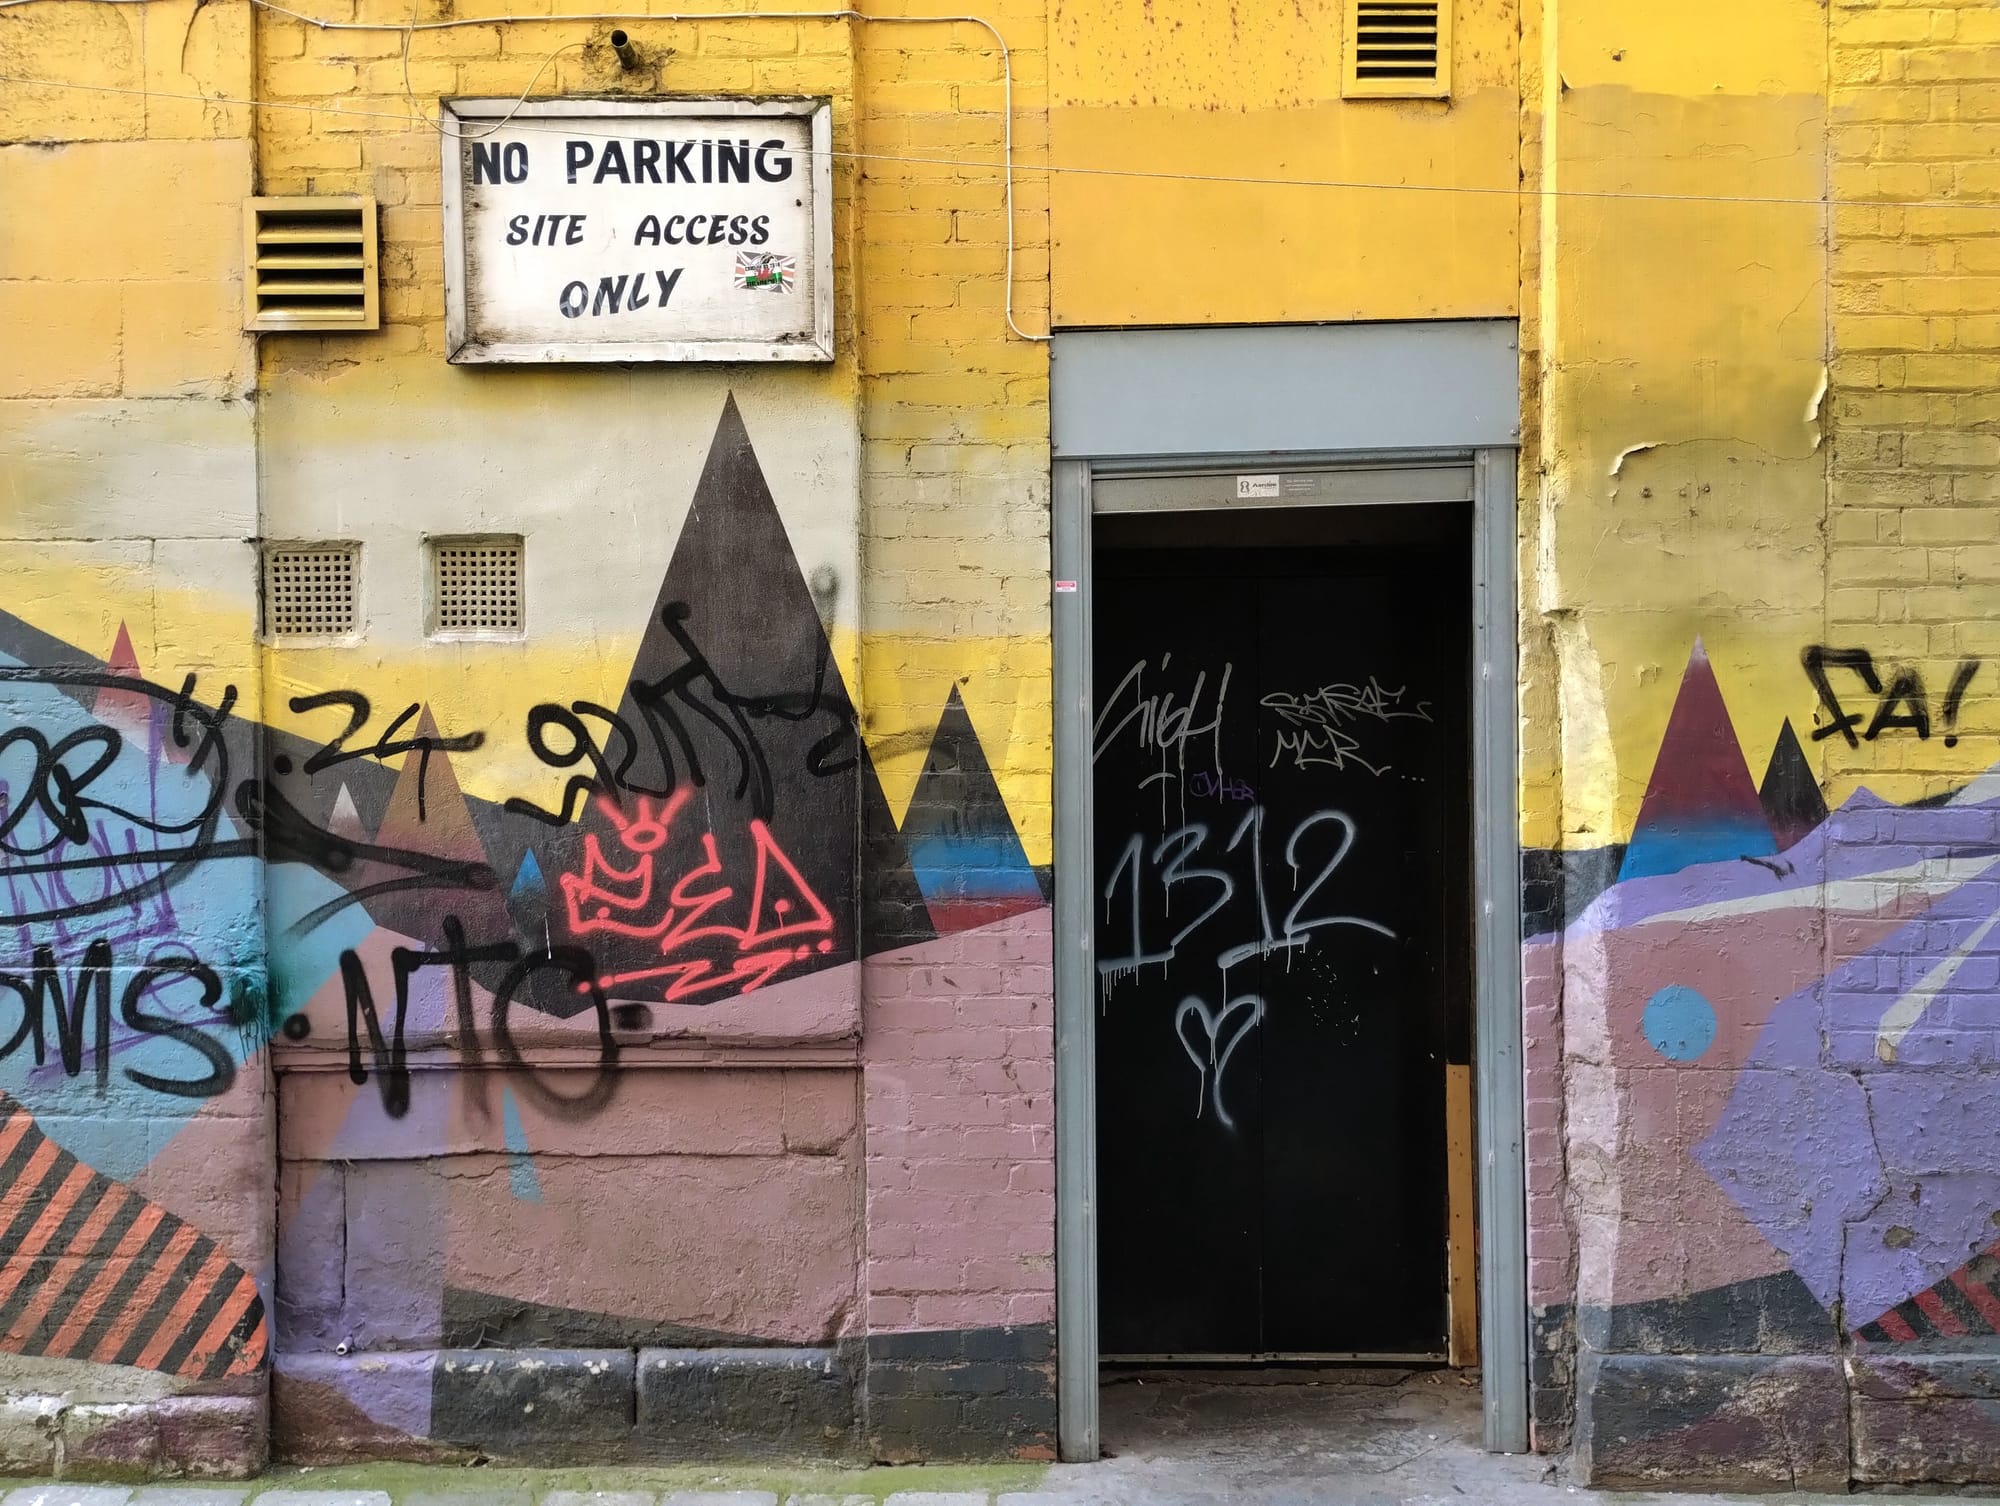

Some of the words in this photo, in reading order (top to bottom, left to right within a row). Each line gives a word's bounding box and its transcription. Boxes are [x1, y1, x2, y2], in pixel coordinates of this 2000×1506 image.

[472, 141, 529, 185] NO
[566, 139, 793, 185] PARKING
[506, 214, 587, 246] SITE
[634, 214, 770, 246] ACCESS
[559, 268, 685, 319] ONLY
[1099, 805, 1397, 968] 1312
